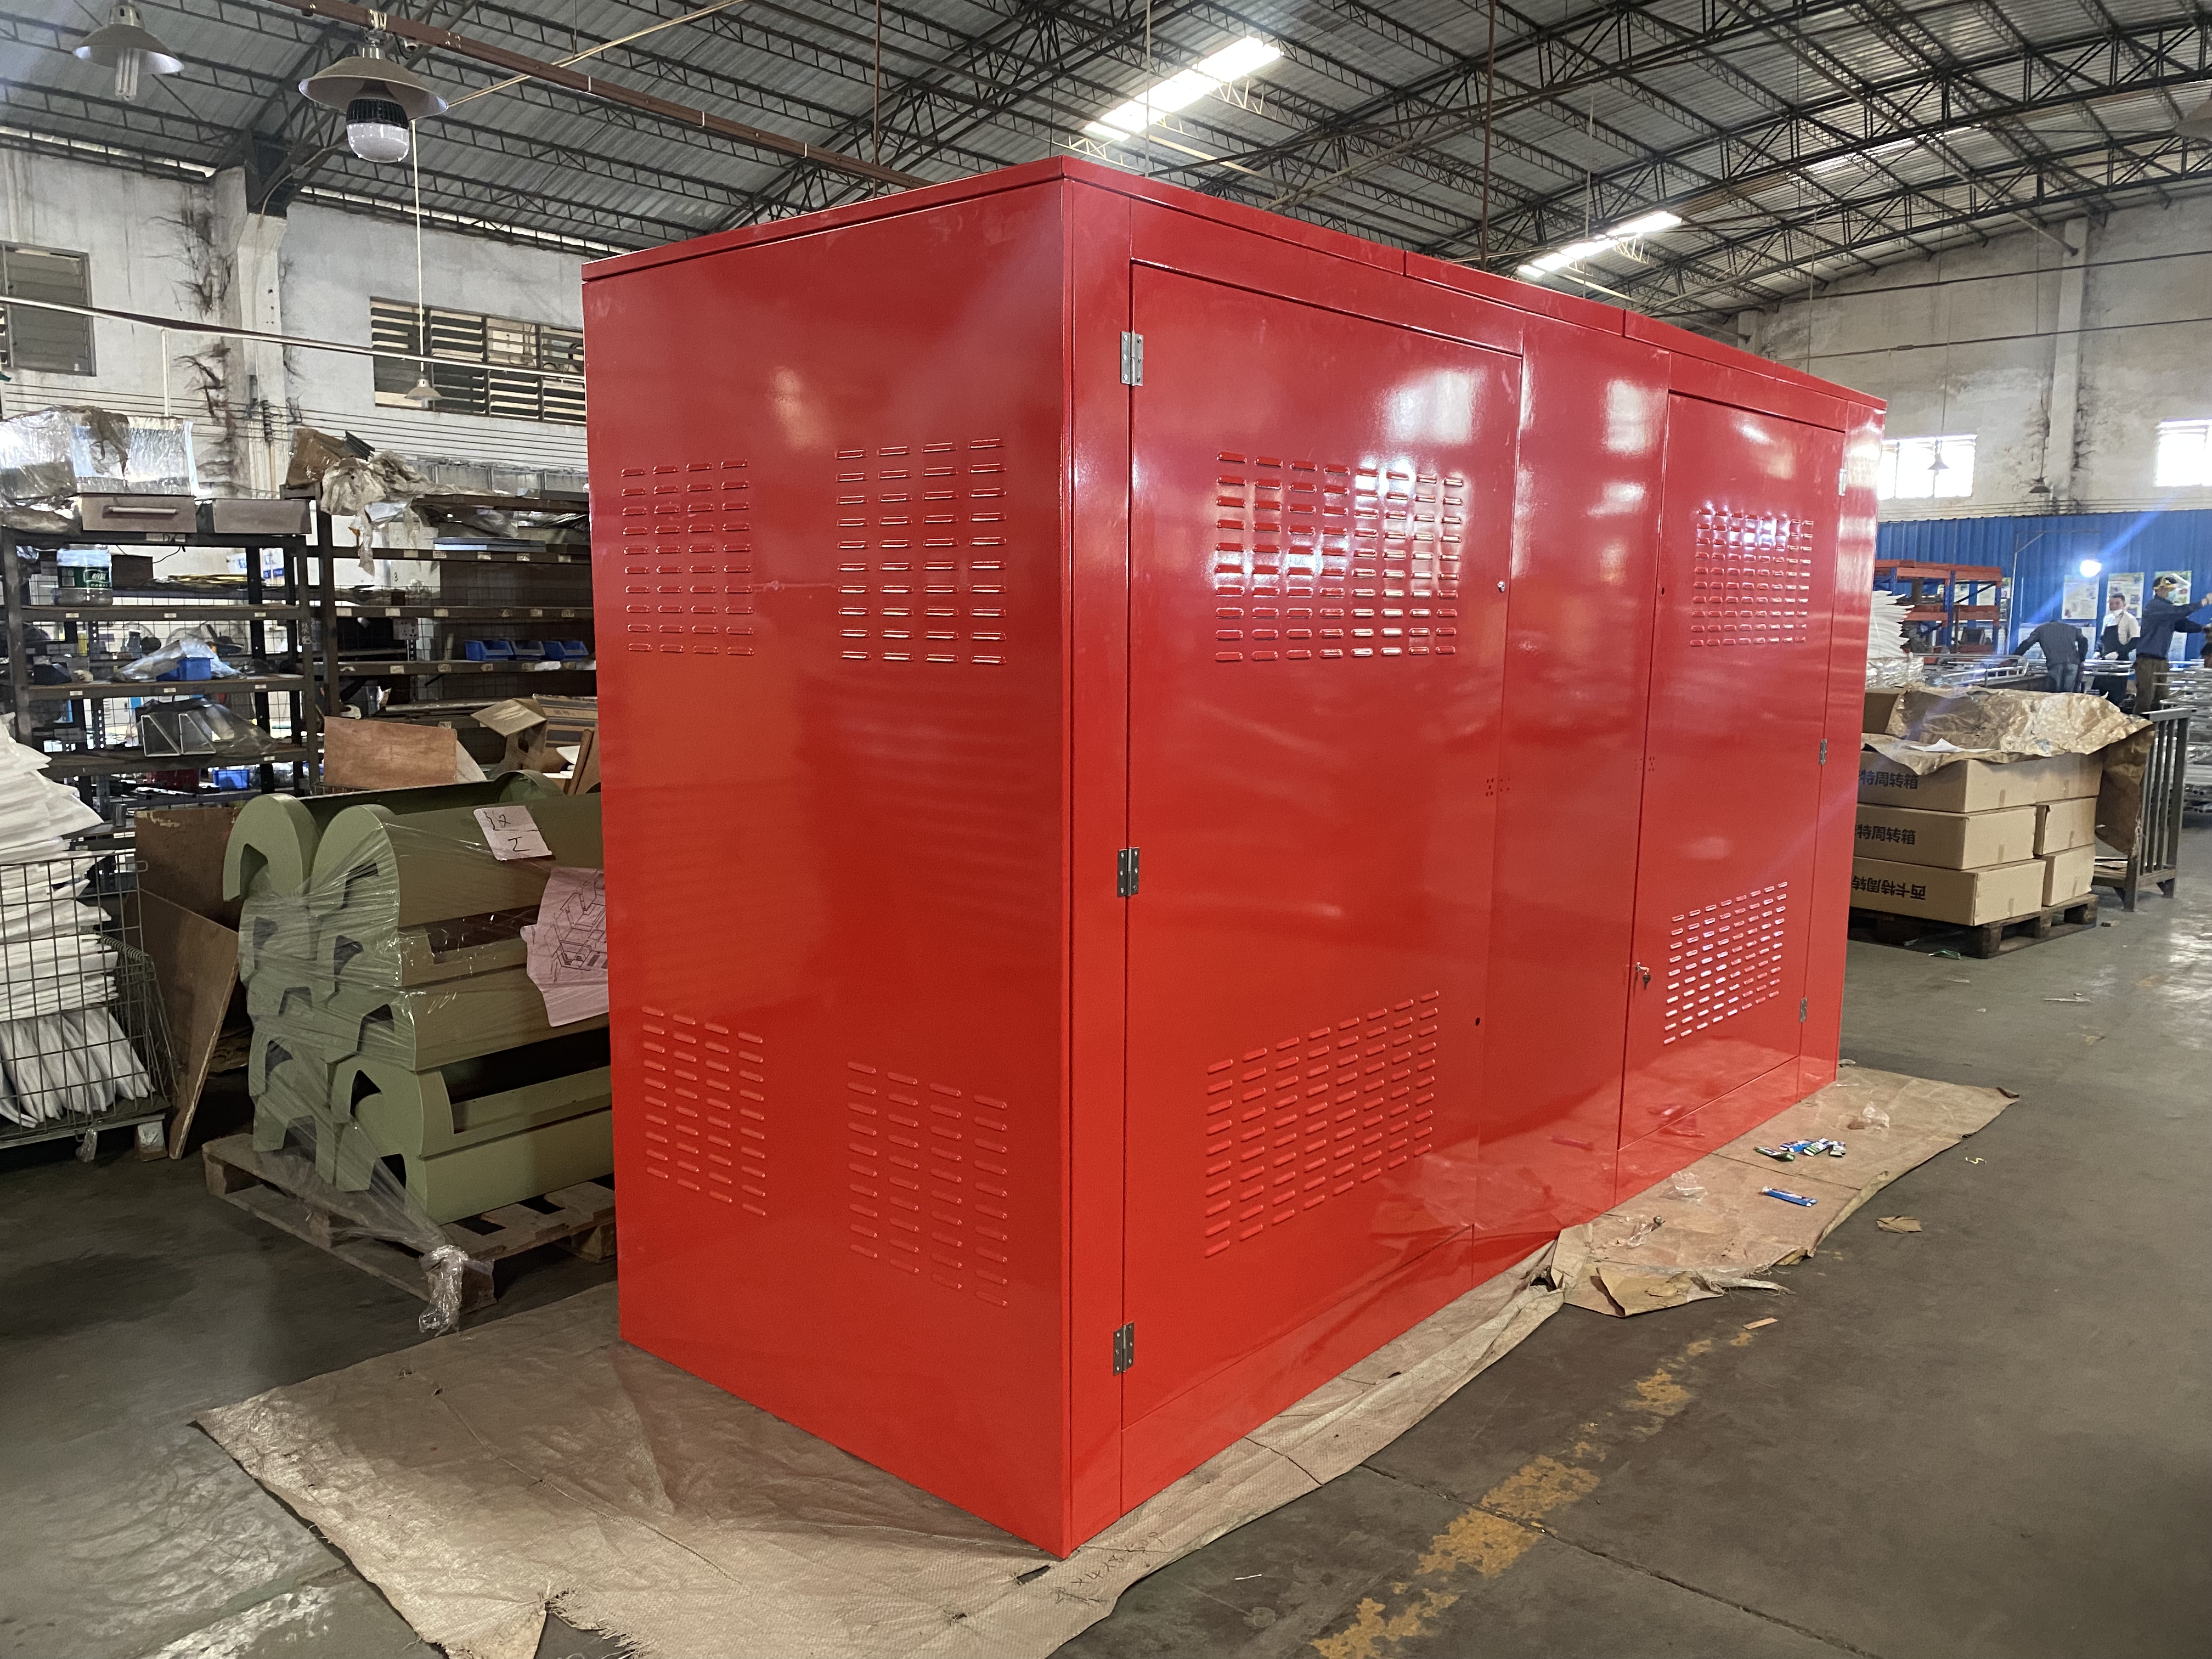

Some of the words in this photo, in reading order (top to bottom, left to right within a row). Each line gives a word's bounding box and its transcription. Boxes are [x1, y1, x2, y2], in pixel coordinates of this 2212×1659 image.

[1858, 769, 1919, 790] 特周转箱
[1854, 823, 1916, 845] 特周转箱
